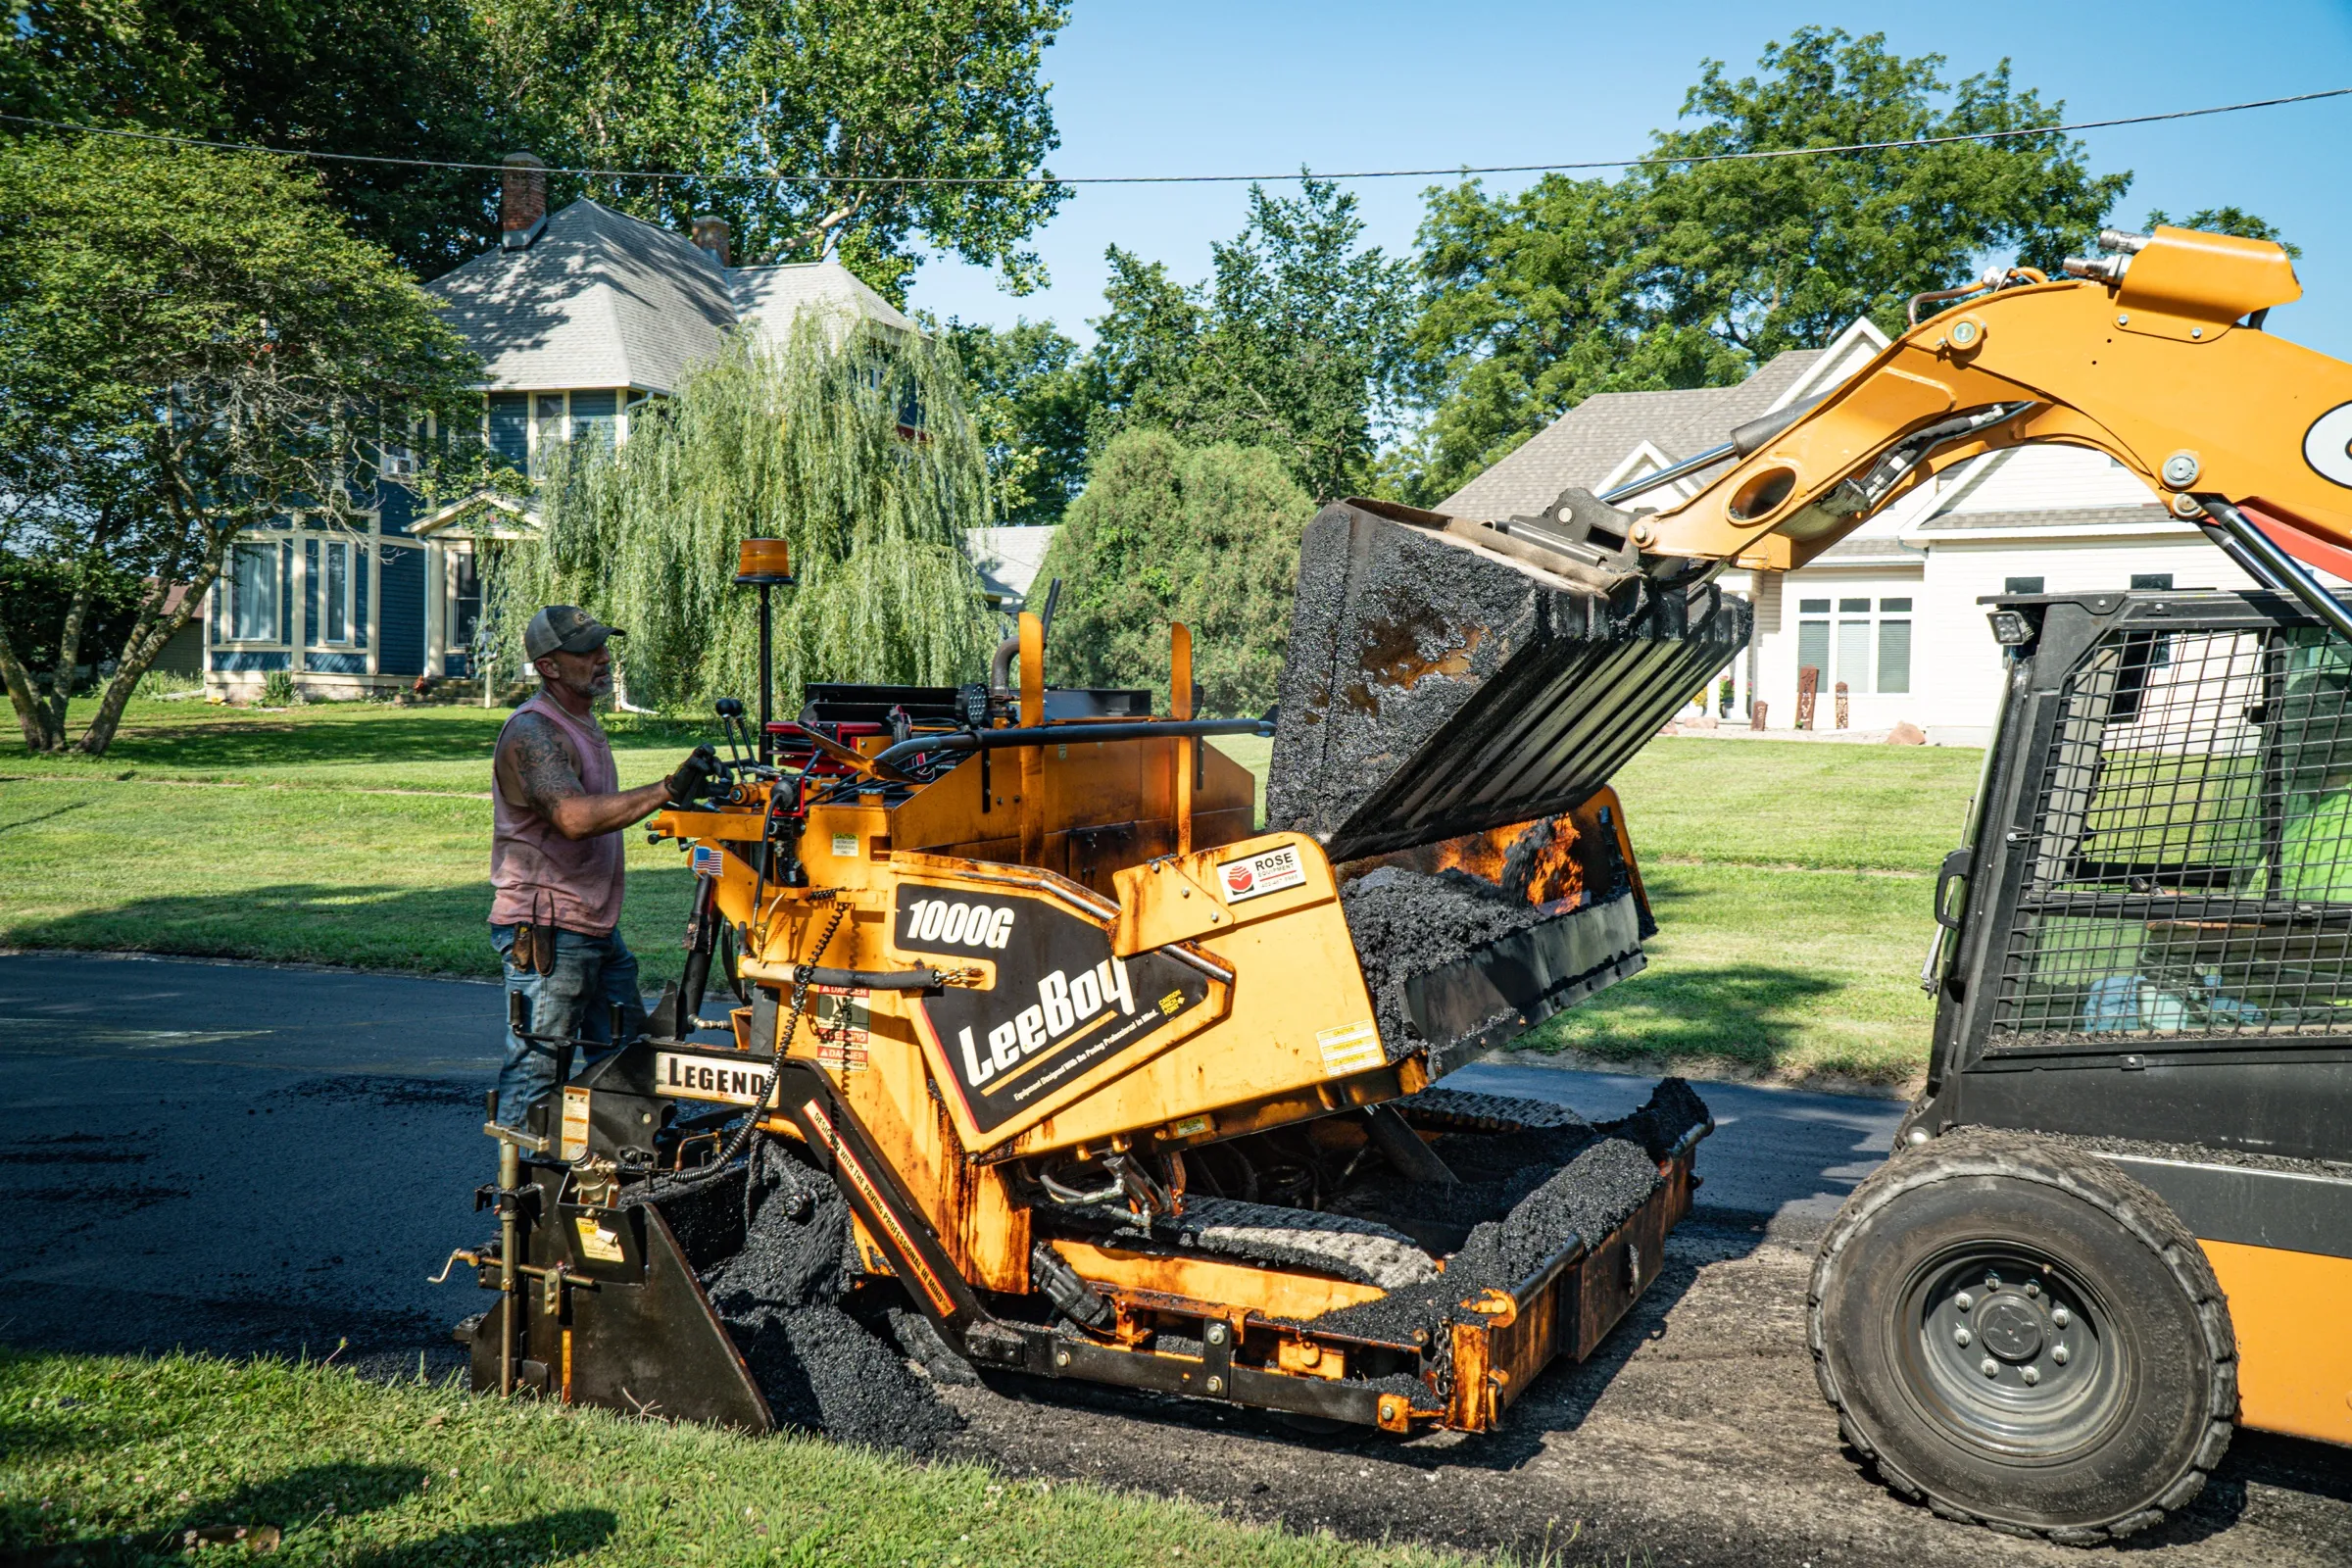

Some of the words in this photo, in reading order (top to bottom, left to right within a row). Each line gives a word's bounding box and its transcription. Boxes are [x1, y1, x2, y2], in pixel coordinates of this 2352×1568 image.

[1255, 853, 1293, 871] ROSE
[1257, 863, 1294, 877] EQUIPMENT
[906, 900, 1015, 949] 1000G
[958, 955, 1136, 1087] LeeBoy
[669, 1057, 765, 1096] LEGEND
[1013, 1080, 1043, 1102] Equipment
[1041, 1066, 1066, 1085] Designed
[1085, 1041, 1106, 1057] Paving
[1103, 1021, 1137, 1046] Professional
[840, 1149, 855, 1171] WITH
[854, 1168, 865, 1187] THE
[863, 1184, 883, 1214] PAVING
[883, 1211, 921, 1270] PROFESSIONAL
[920, 1268, 930, 1282] IN
